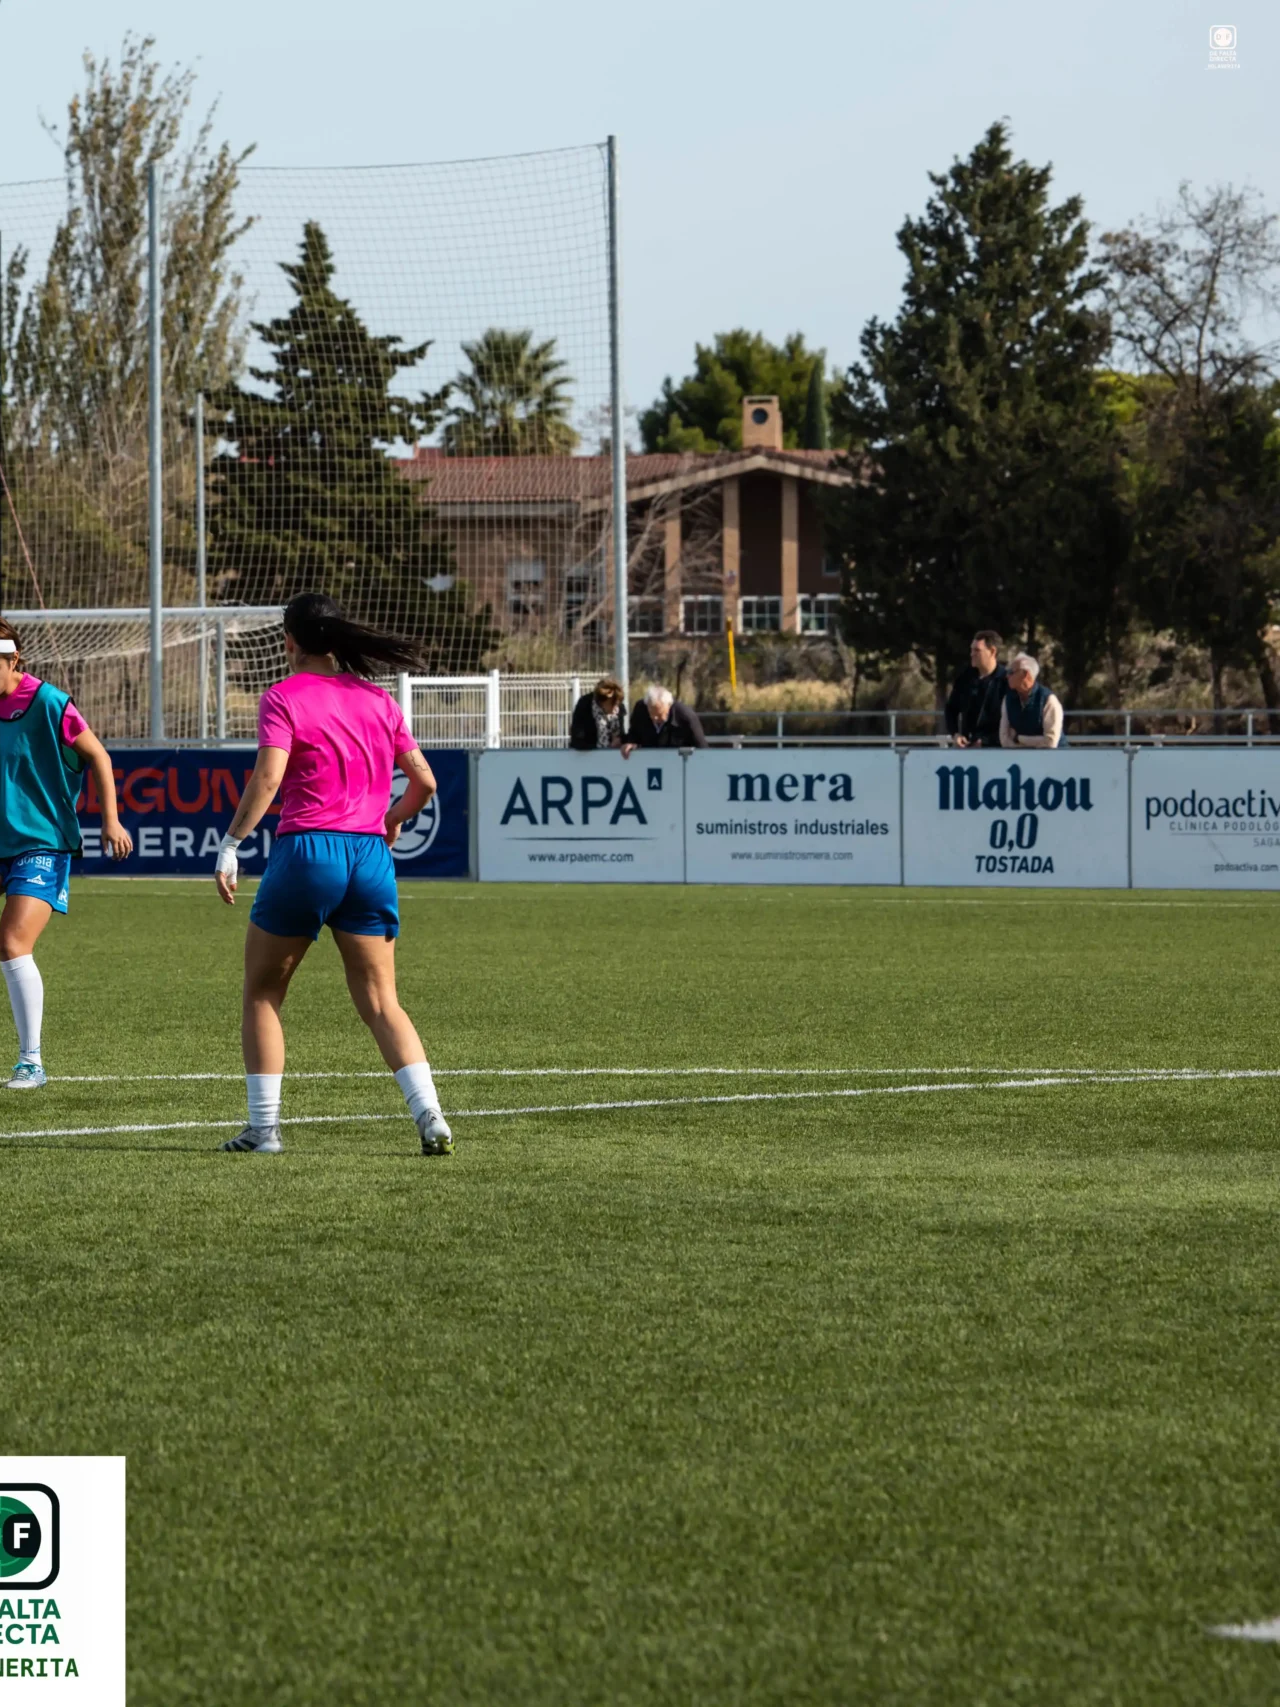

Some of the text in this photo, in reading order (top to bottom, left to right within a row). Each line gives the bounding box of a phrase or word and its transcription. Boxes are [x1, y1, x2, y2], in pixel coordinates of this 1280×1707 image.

[726, 772, 855, 803] mera
[935, 763, 1094, 812] Mahou
[500, 775, 648, 826] ARPA
[1145, 789, 1280, 831] podoactiv
[695, 818, 890, 836] suministros industriales
[988, 812, 1039, 852] 0,0
[1169, 819, 1218, 832] CLÍNICA
[528, 852, 634, 864] www.arpaemc.com
[730, 850, 854, 862] www.suministrosmera.com
[975, 855, 1055, 874] TOSTADA
